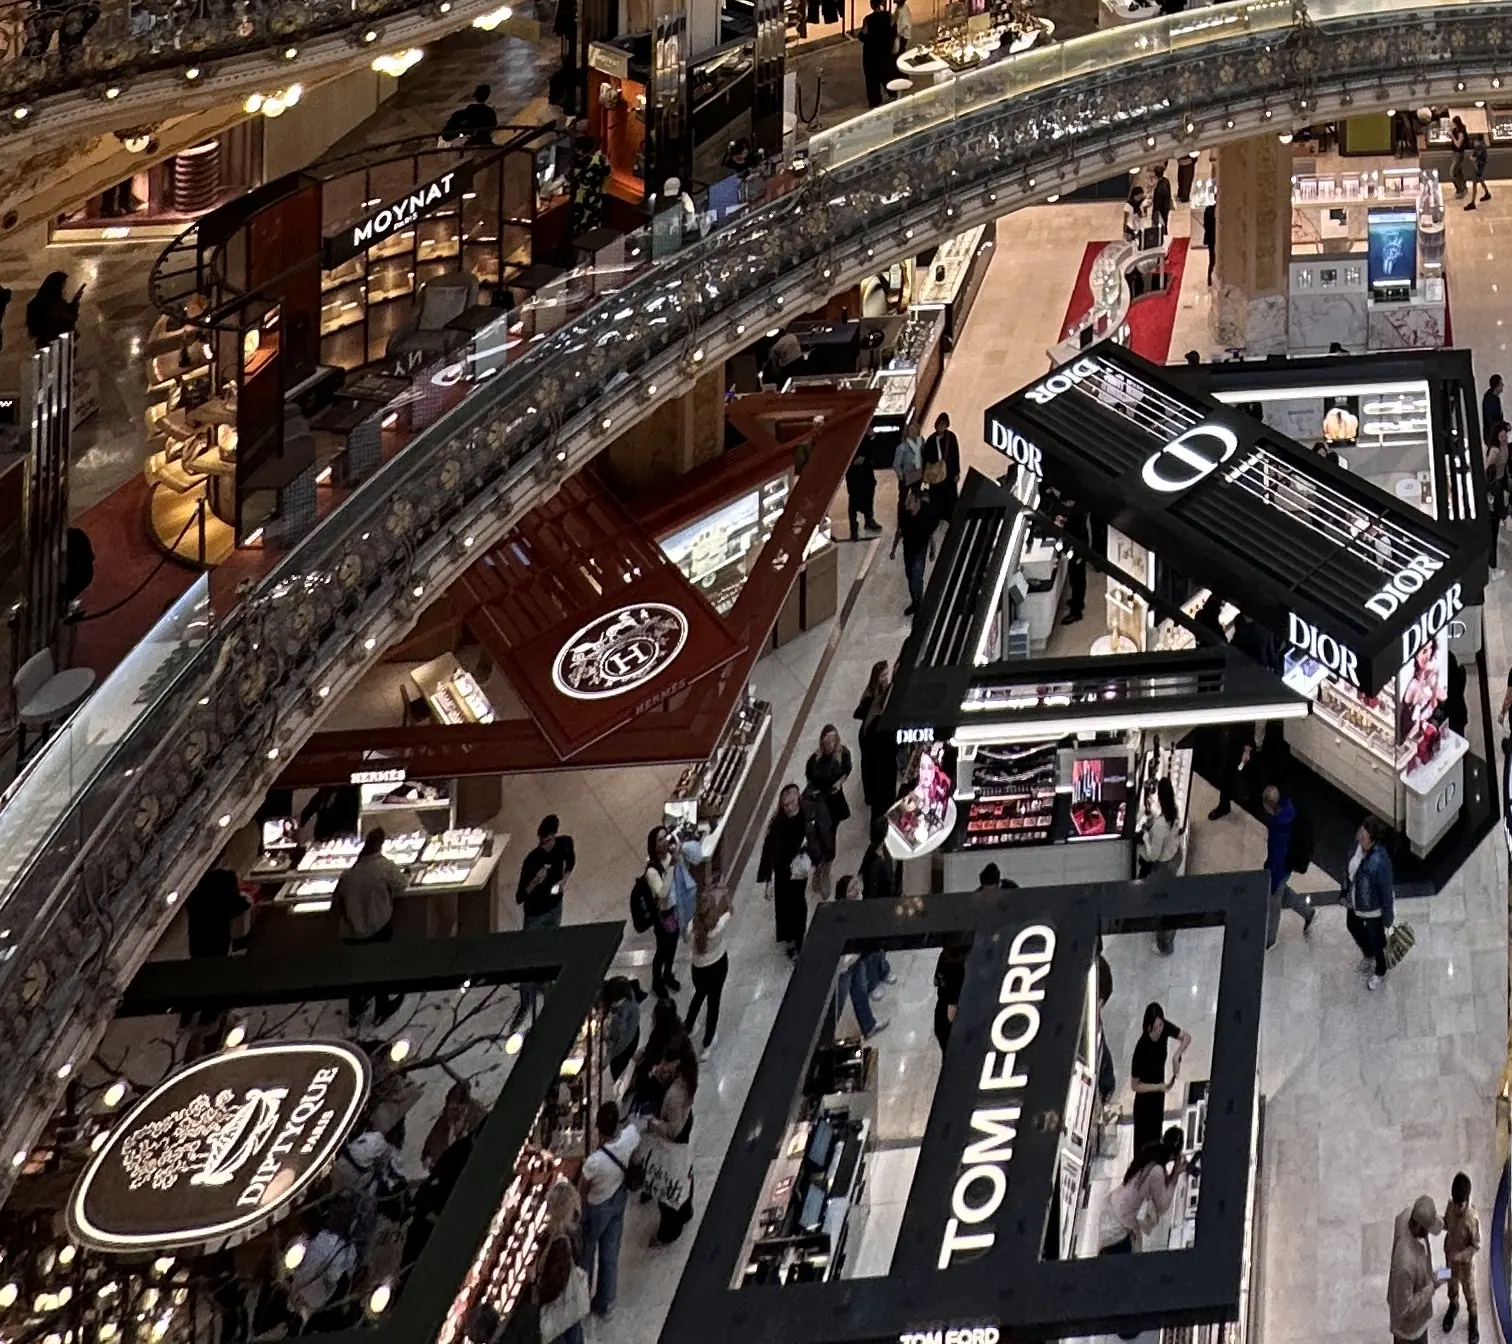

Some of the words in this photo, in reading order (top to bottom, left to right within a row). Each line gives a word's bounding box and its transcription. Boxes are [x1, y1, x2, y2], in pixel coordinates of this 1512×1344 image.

[353, 172, 455, 247] MOYNAT
[1024, 357, 1101, 405] DIOR
[991, 419, 1044, 478] DIOR
[1364, 554, 1444, 621] DIOR
[609, 641, 650, 675] H
[1289, 611, 1361, 687] DIOR
[1401, 582, 1464, 665] DIOR
[896, 727, 935, 745] DIOR
[978, 924, 1057, 1091] FORD
[236, 1066, 340, 1208] DIPTYQUE
[937, 1106, 1022, 1271] TOM
[944, 1327, 1000, 1344] FORD
